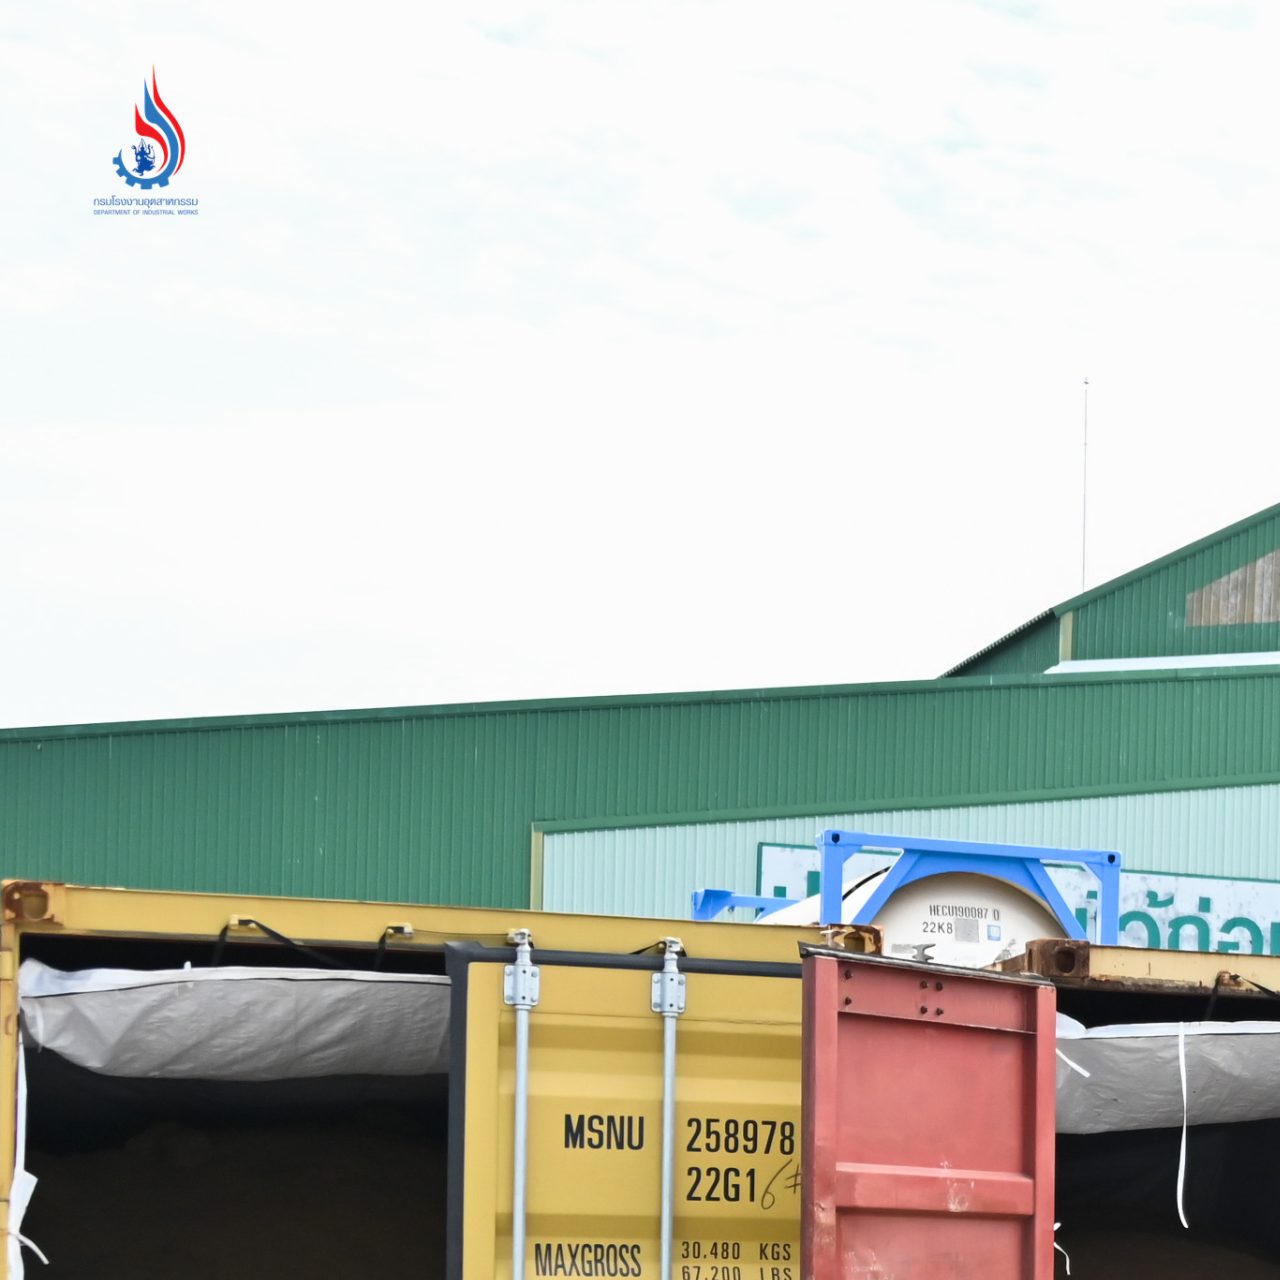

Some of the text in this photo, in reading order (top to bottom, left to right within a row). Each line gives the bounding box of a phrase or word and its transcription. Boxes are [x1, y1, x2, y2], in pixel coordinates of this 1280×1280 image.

[922, 921, 953, 934] 22K8
[929, 904, 988, 919] HECU190087
[564, 1114, 795, 1155] MSNU 258978
[686, 1166, 756, 1202] 22G1
[534, 1242, 792, 1278] MAXGROSS KGS
